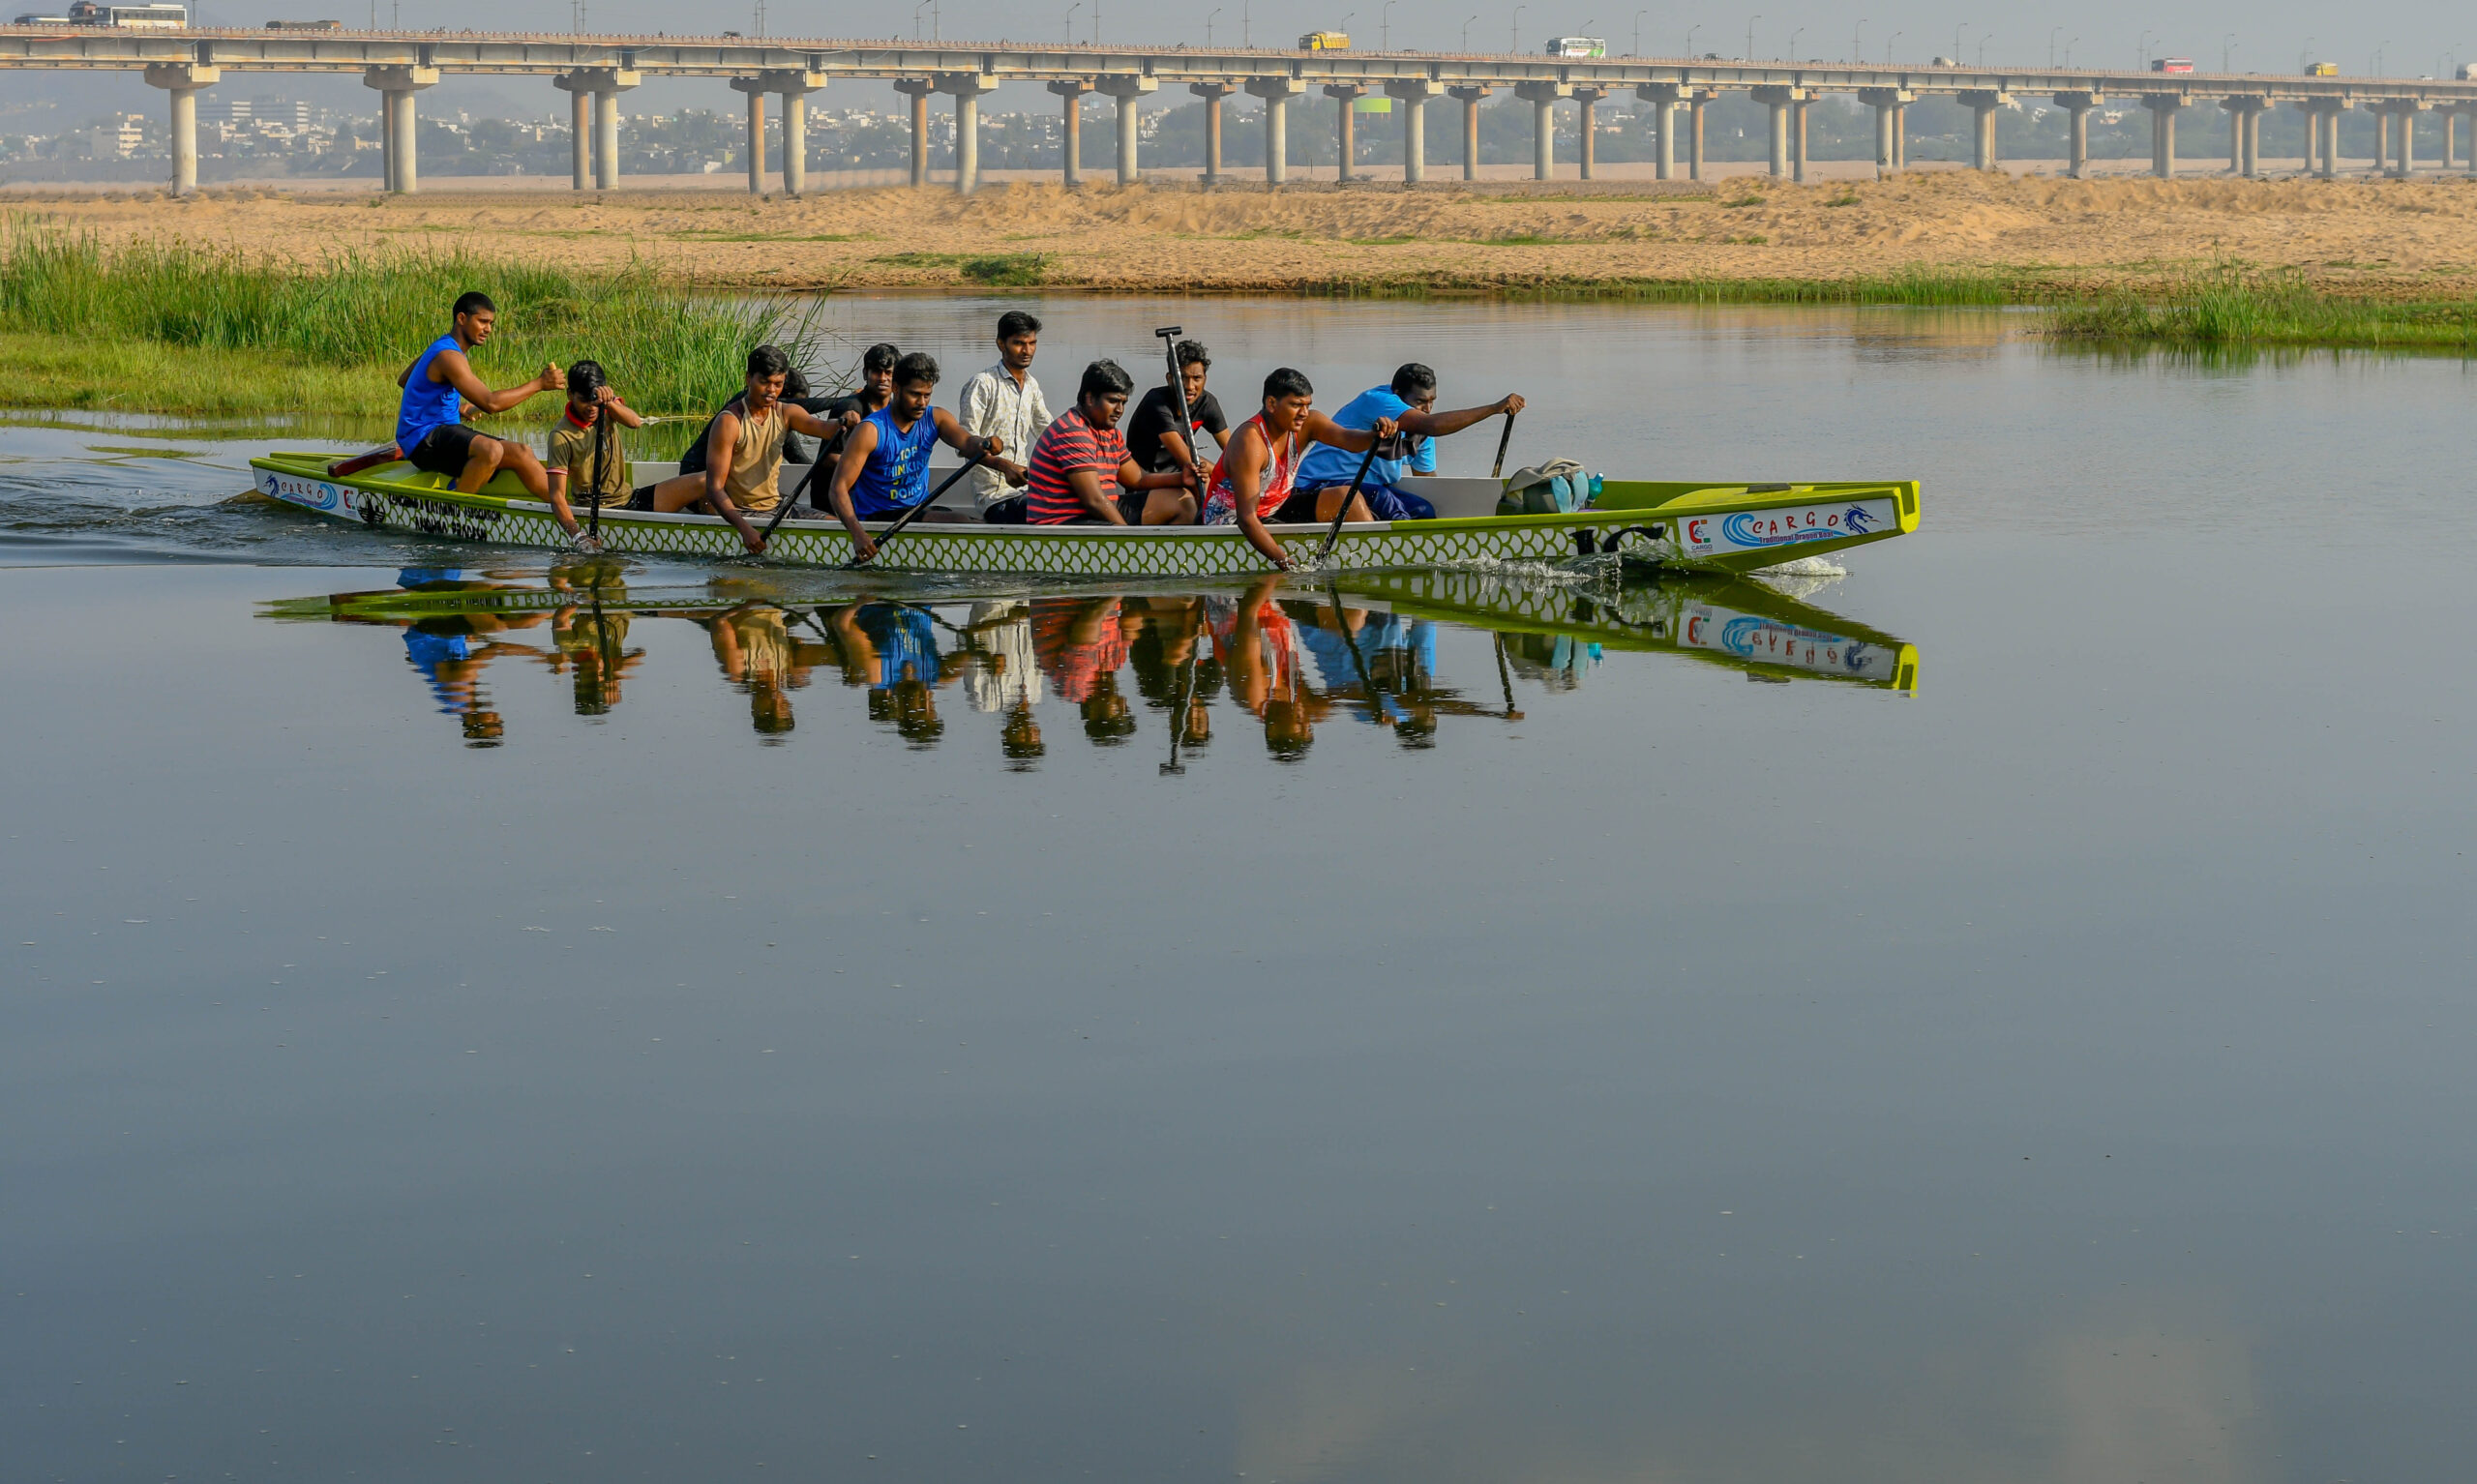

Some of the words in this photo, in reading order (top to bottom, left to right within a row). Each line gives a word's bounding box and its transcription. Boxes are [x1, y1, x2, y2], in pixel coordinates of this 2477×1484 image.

[883, 457, 928, 478] THINKIN
[281, 481, 323, 499] CARGO
[1752, 511, 1838, 535] CARGO
[1759, 533, 1794, 544] Traditional
[1794, 531, 1817, 542] Dragon
[1818, 531, 1834, 540] Boat
[1691, 543, 1713, 551] CARGO
